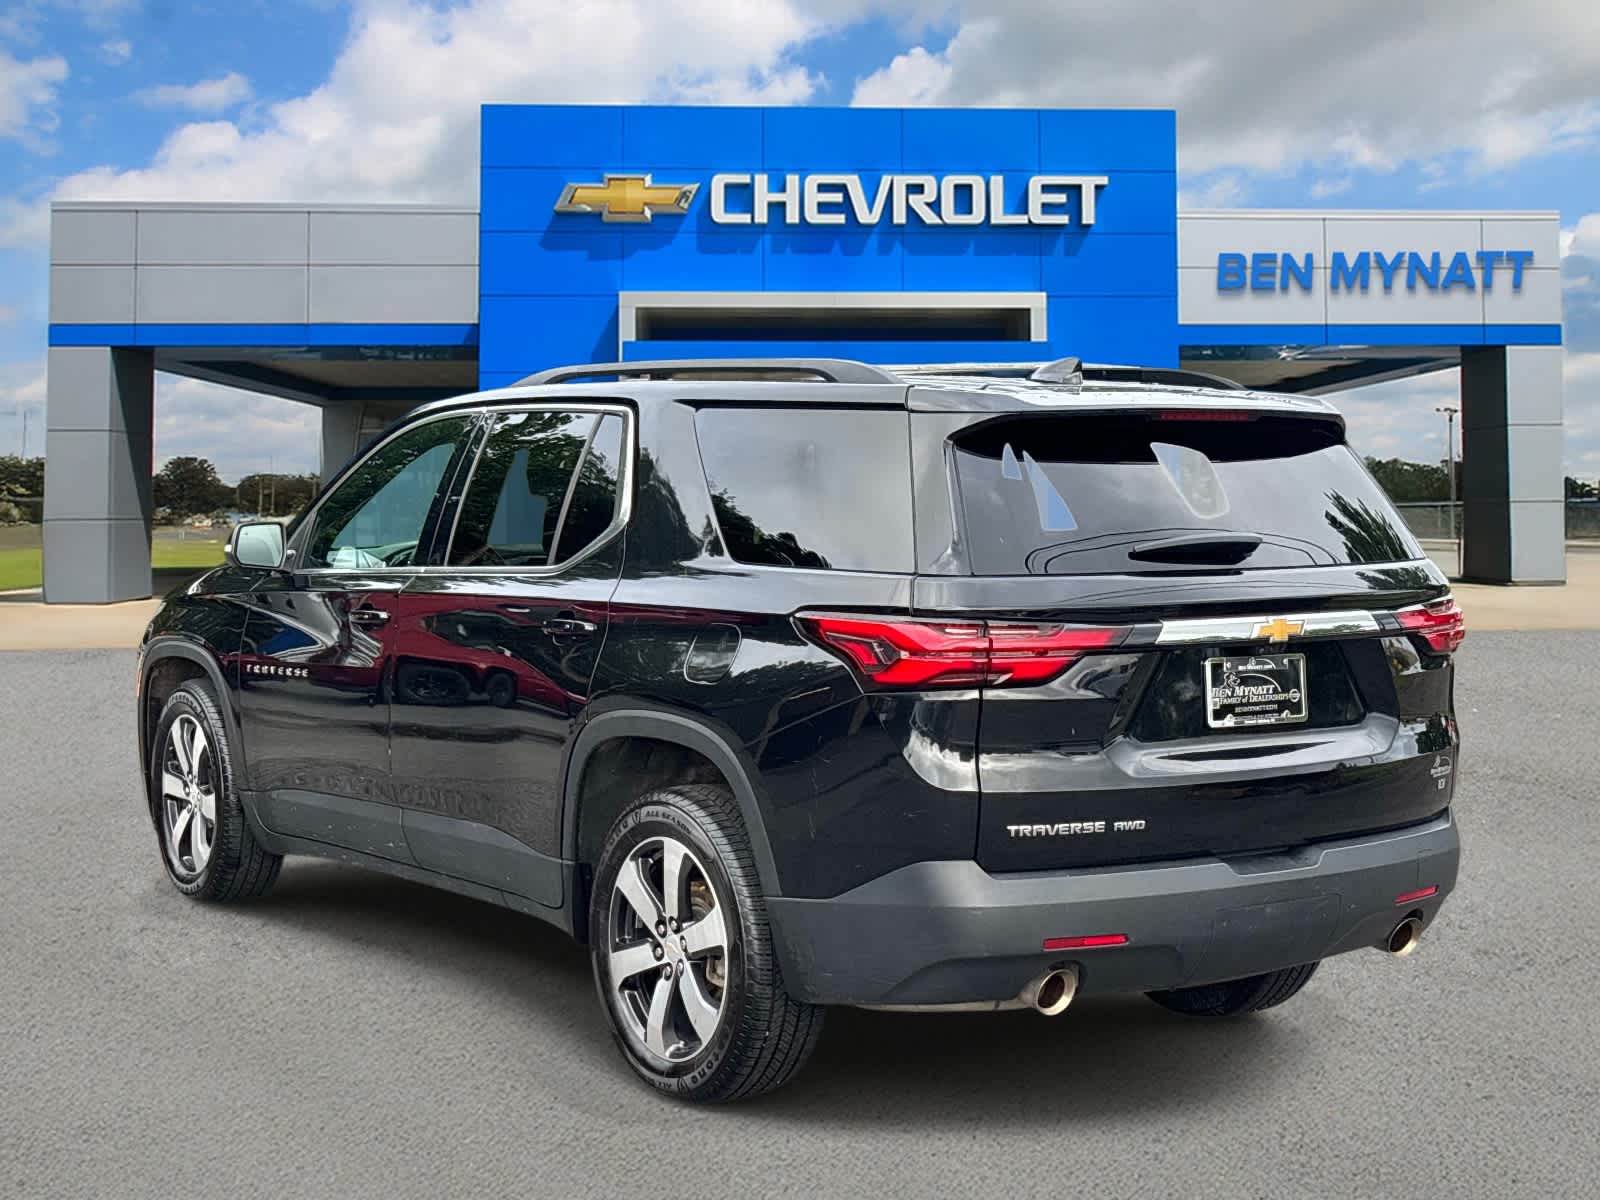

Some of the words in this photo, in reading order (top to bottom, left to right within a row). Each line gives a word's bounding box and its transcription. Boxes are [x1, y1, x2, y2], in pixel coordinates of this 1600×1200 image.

[711, 173, 1109, 225] CHEVROLET
[1217, 252, 1314, 290] BEN
[1330, 250, 1534, 290] MYNATT
[1234, 685, 1276, 697] MYNATT
[1006, 821, 1106, 838] TRAVERSE
[1113, 820, 1147, 832] AWD
